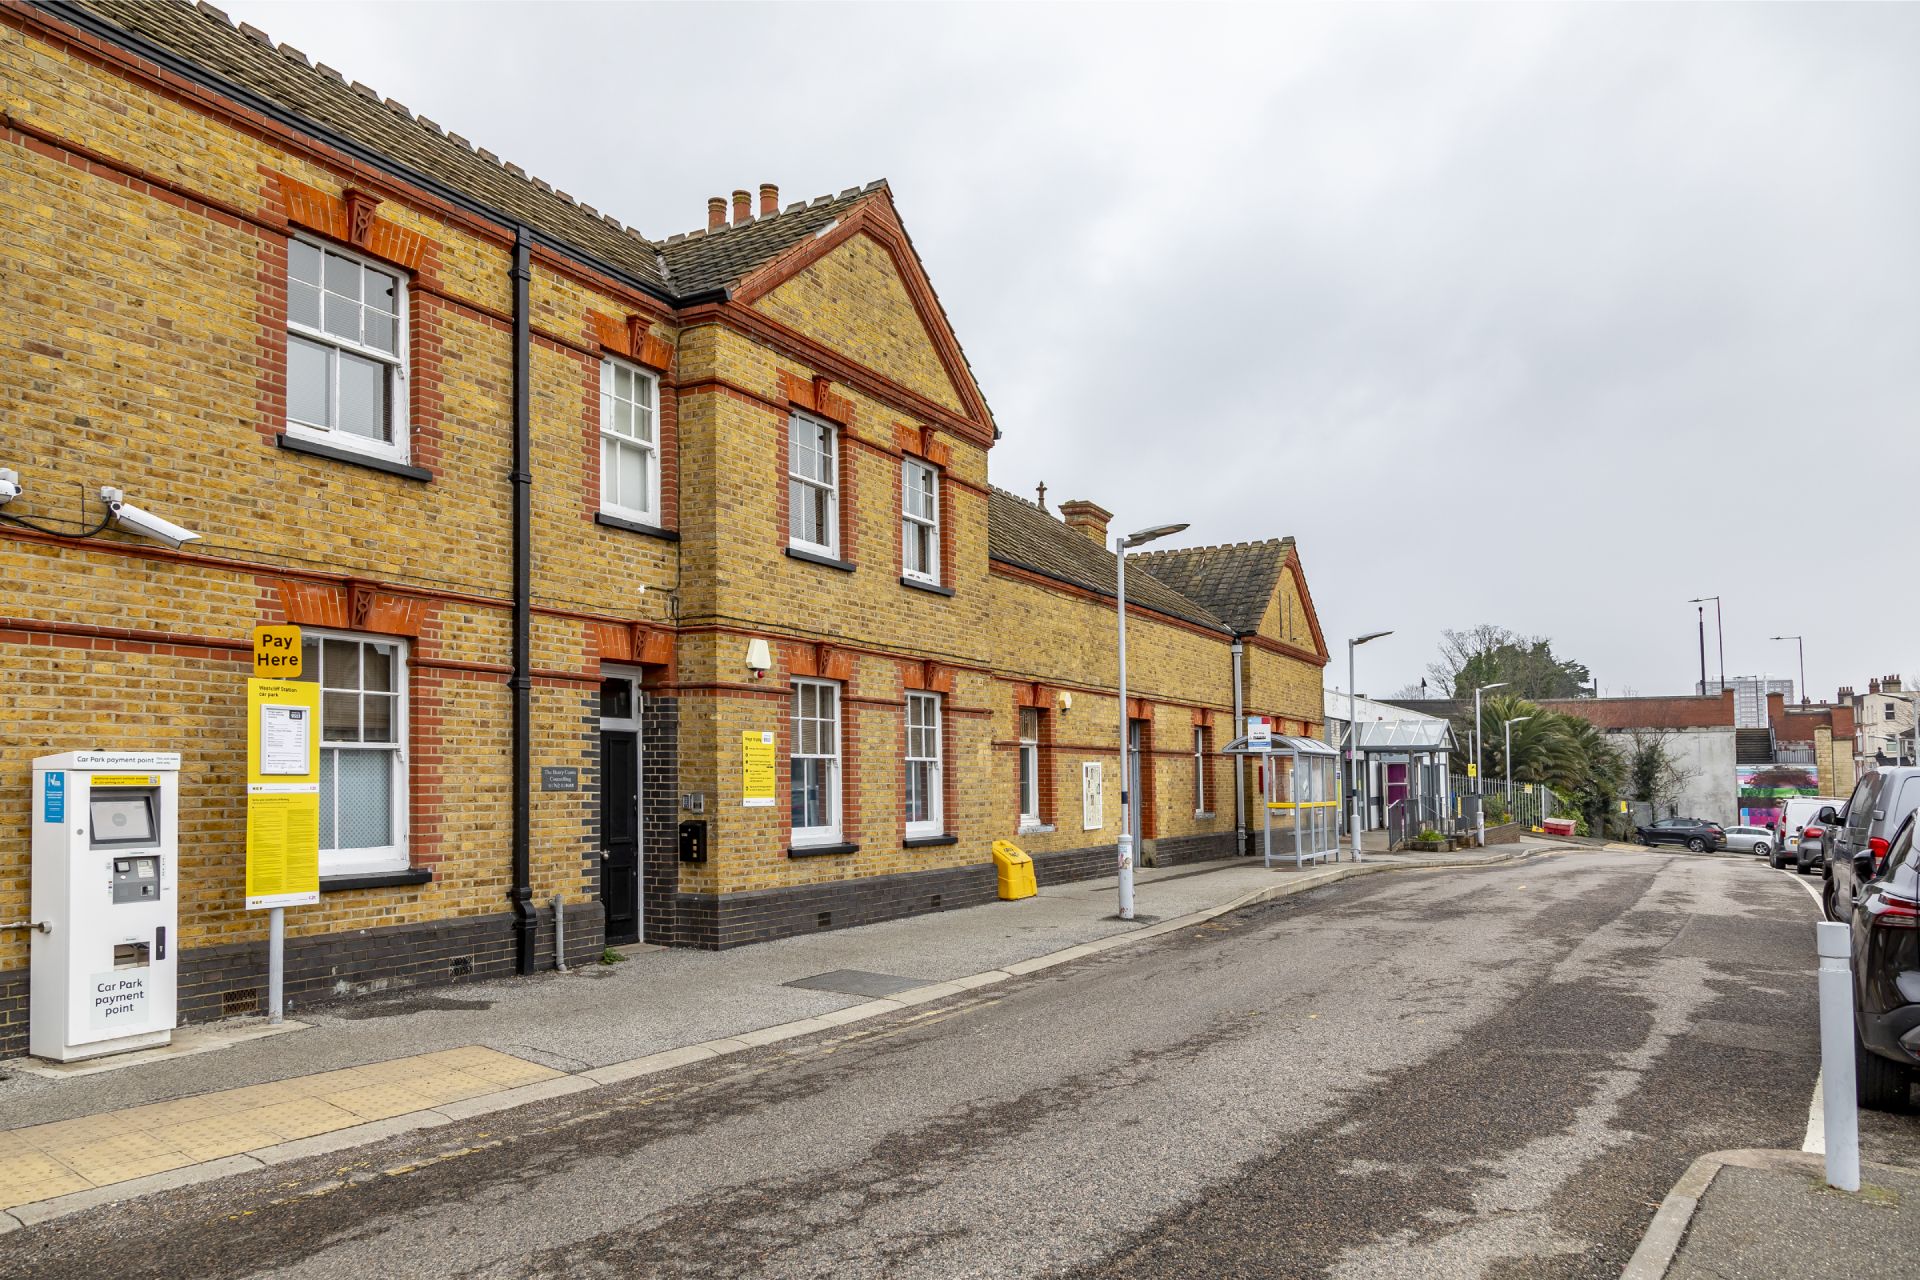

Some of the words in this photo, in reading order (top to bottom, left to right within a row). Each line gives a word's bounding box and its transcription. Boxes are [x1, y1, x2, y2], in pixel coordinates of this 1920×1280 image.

[262, 634, 293, 650] Pay
[257, 653, 299, 666] Here
[77, 755, 89, 763] Car
[137, 756, 154, 764] point
[97, 982, 117, 993] Car
[119, 978, 143, 990] Park
[95, 990, 145, 1008] payment
[105, 1003, 135, 1018] point
